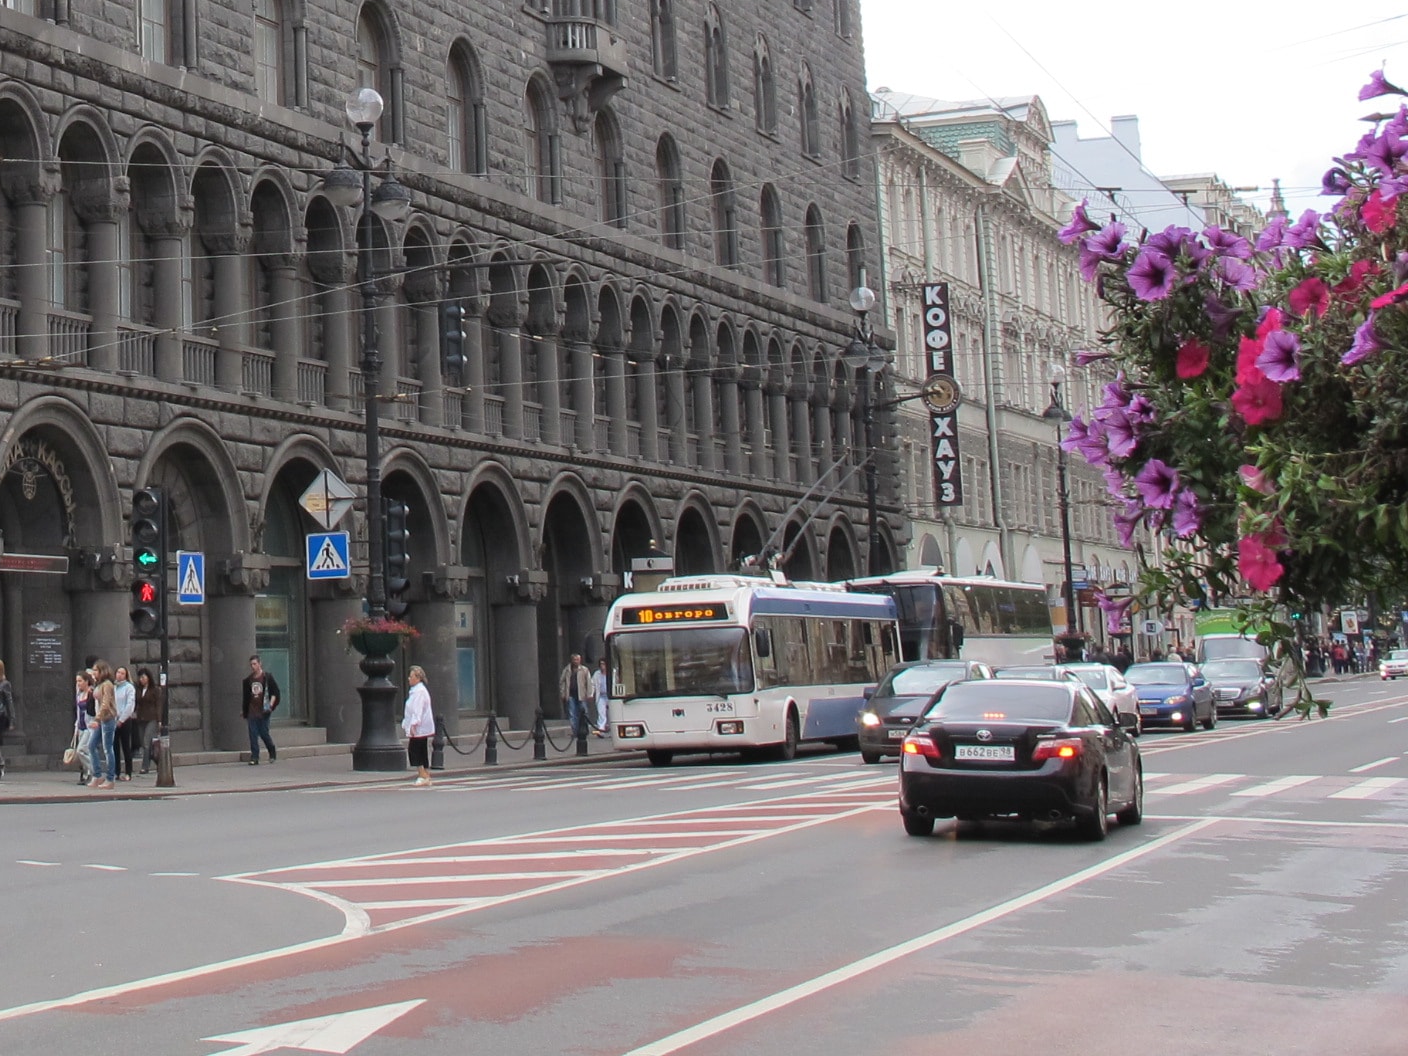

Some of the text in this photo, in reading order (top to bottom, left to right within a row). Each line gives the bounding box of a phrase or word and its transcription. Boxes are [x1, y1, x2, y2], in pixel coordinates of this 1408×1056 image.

[925, 285, 949, 371] КОФЕ
[38, 443, 77, 513] КАССЫ
[933, 416, 956, 502] ХАУЗ
[615, 684, 624, 694] 10
[706, 702, 733, 712] 3428
